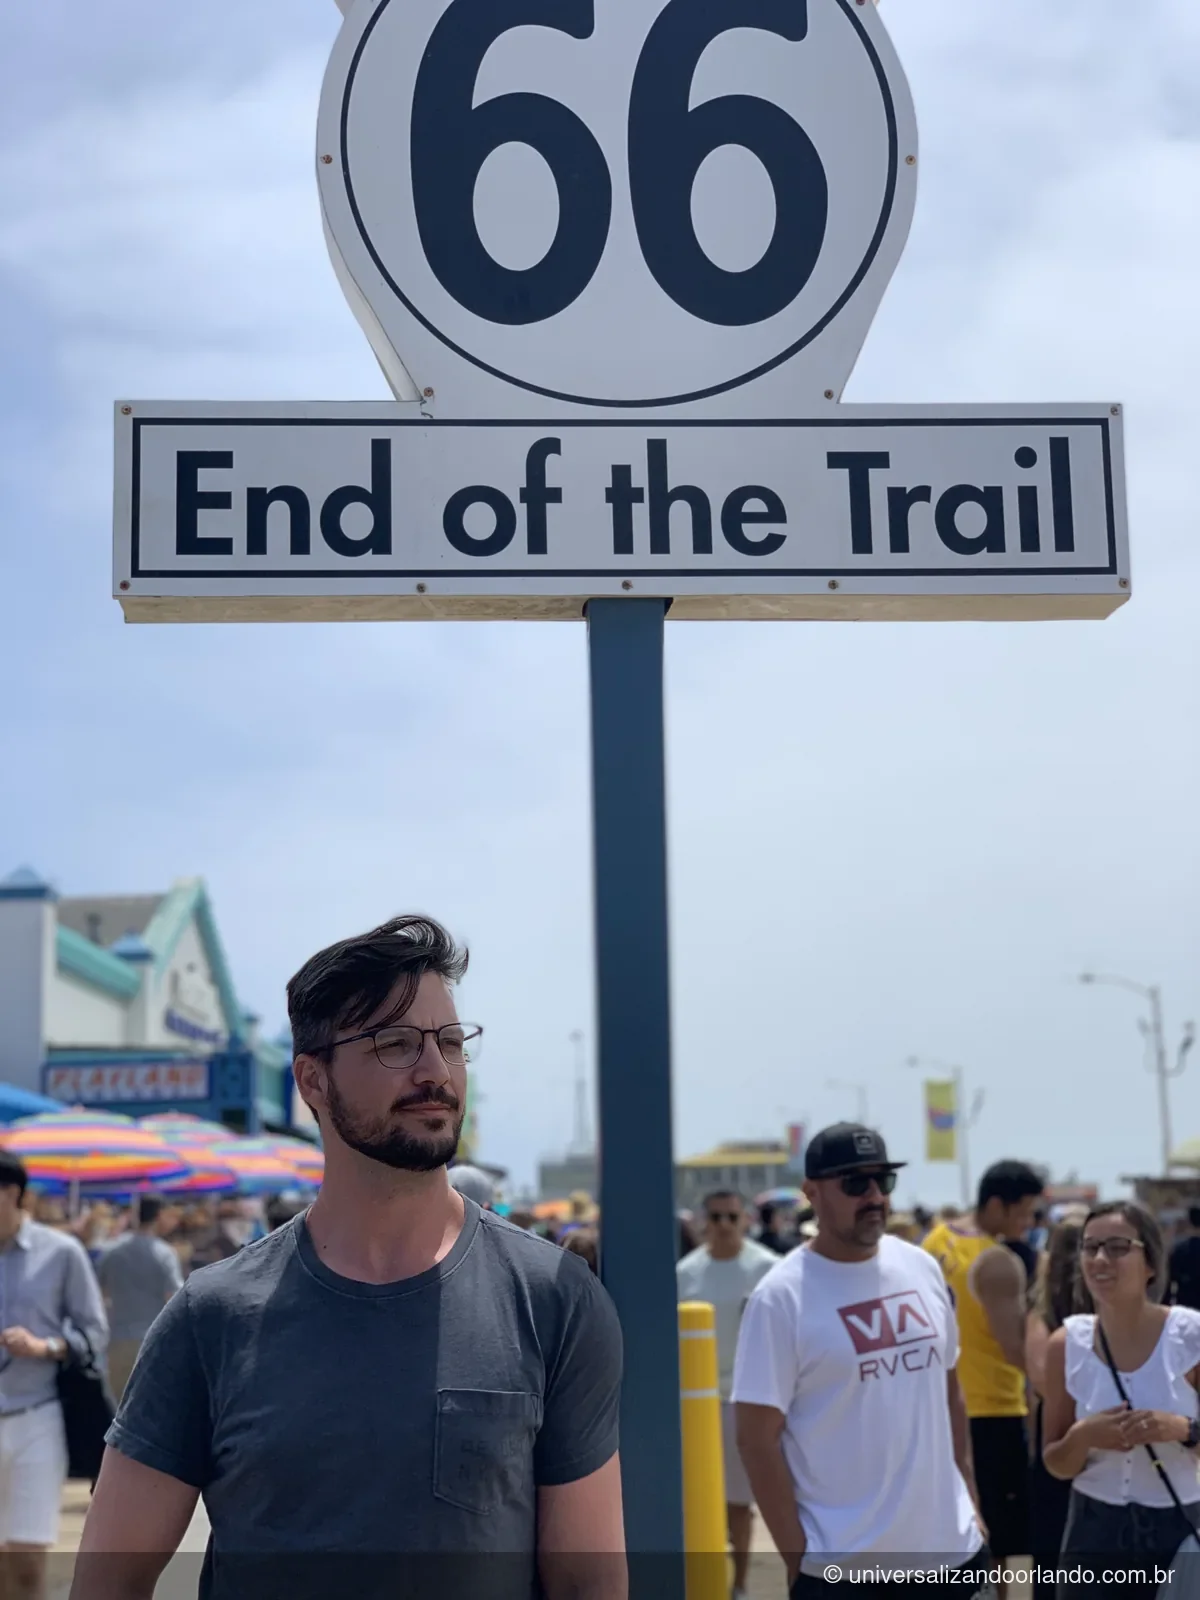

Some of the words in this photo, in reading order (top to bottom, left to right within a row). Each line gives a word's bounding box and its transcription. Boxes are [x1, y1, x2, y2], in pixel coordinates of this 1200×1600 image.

[411, 0, 828, 327] 66
[176, 439, 392, 557] End
[443, 437, 562, 557] of
[605, 439, 787, 556] the
[827, 437, 1074, 555] Trail
[859, 1346, 942, 1382] RVCA
